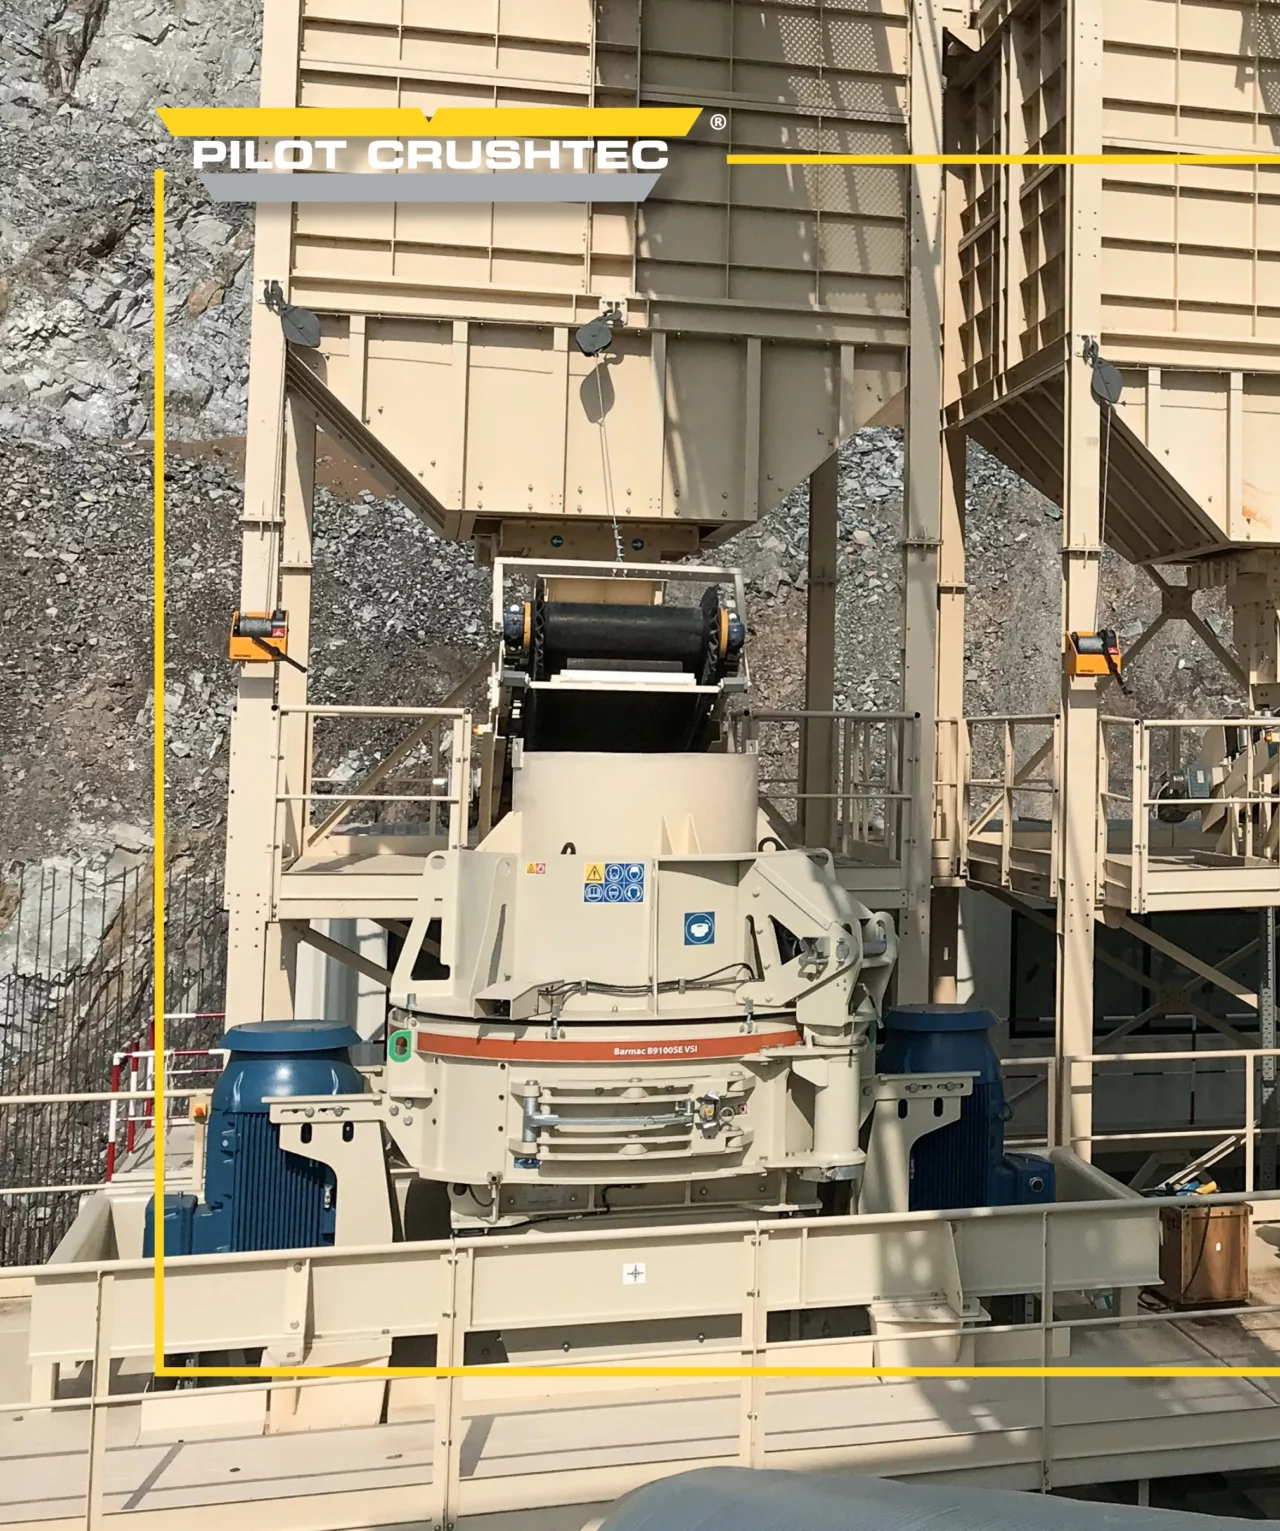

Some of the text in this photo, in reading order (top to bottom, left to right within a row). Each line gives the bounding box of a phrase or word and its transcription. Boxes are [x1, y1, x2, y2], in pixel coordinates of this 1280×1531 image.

[613, 1045, 698, 1056] Barmac B9100SE VSI
